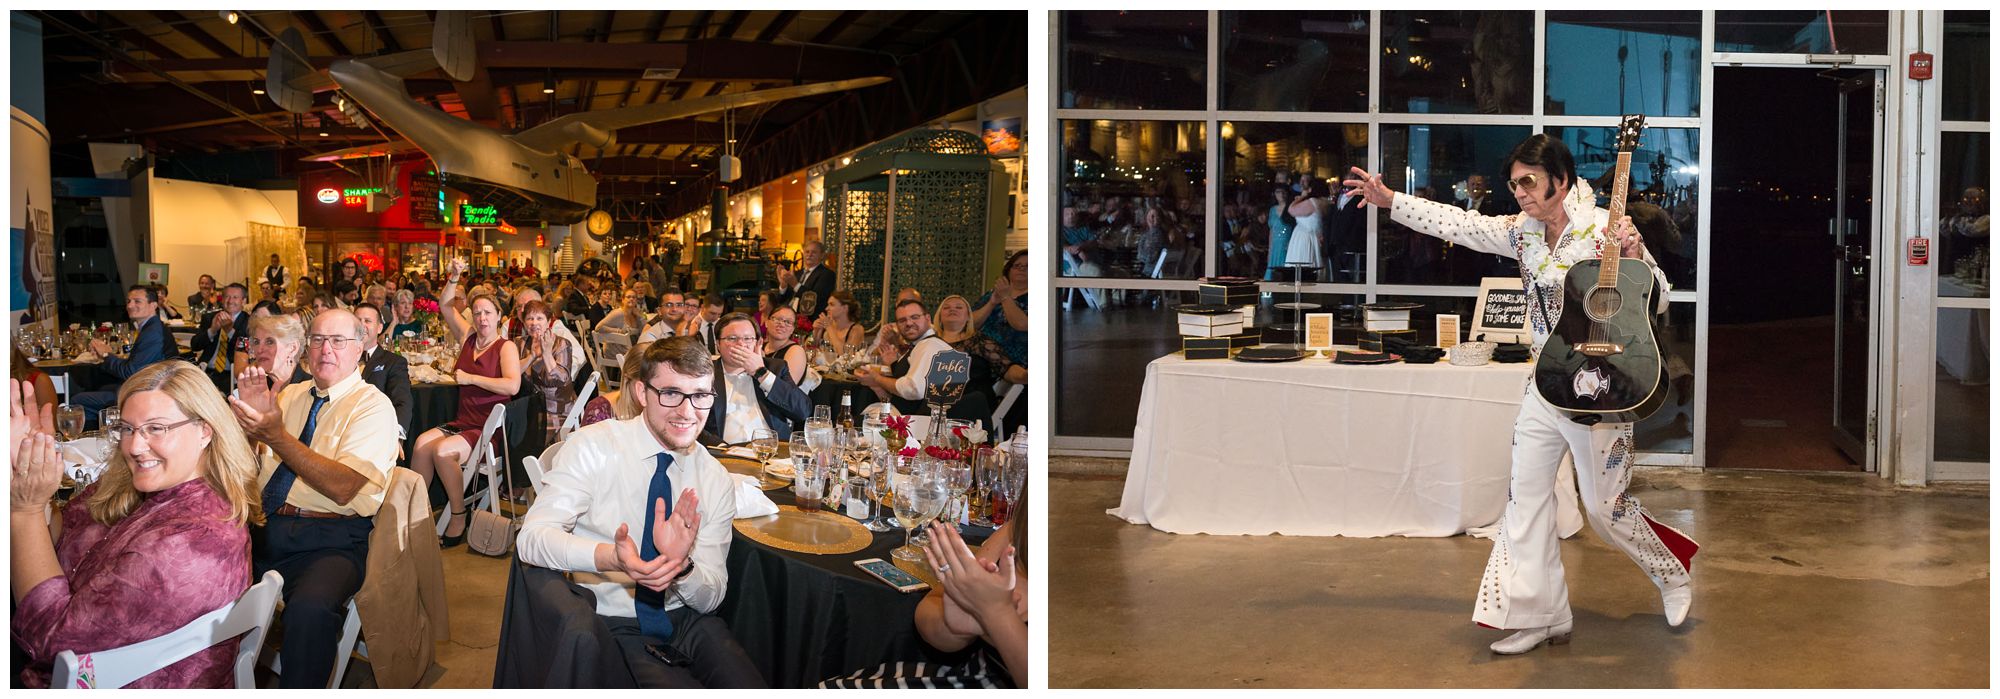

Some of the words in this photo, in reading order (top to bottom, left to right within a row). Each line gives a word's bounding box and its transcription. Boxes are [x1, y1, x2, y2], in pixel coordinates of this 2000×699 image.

[465, 215, 496, 224] Radio
[1493, 314, 1508, 324] SOME
[1511, 315, 1525, 323] CAKE
